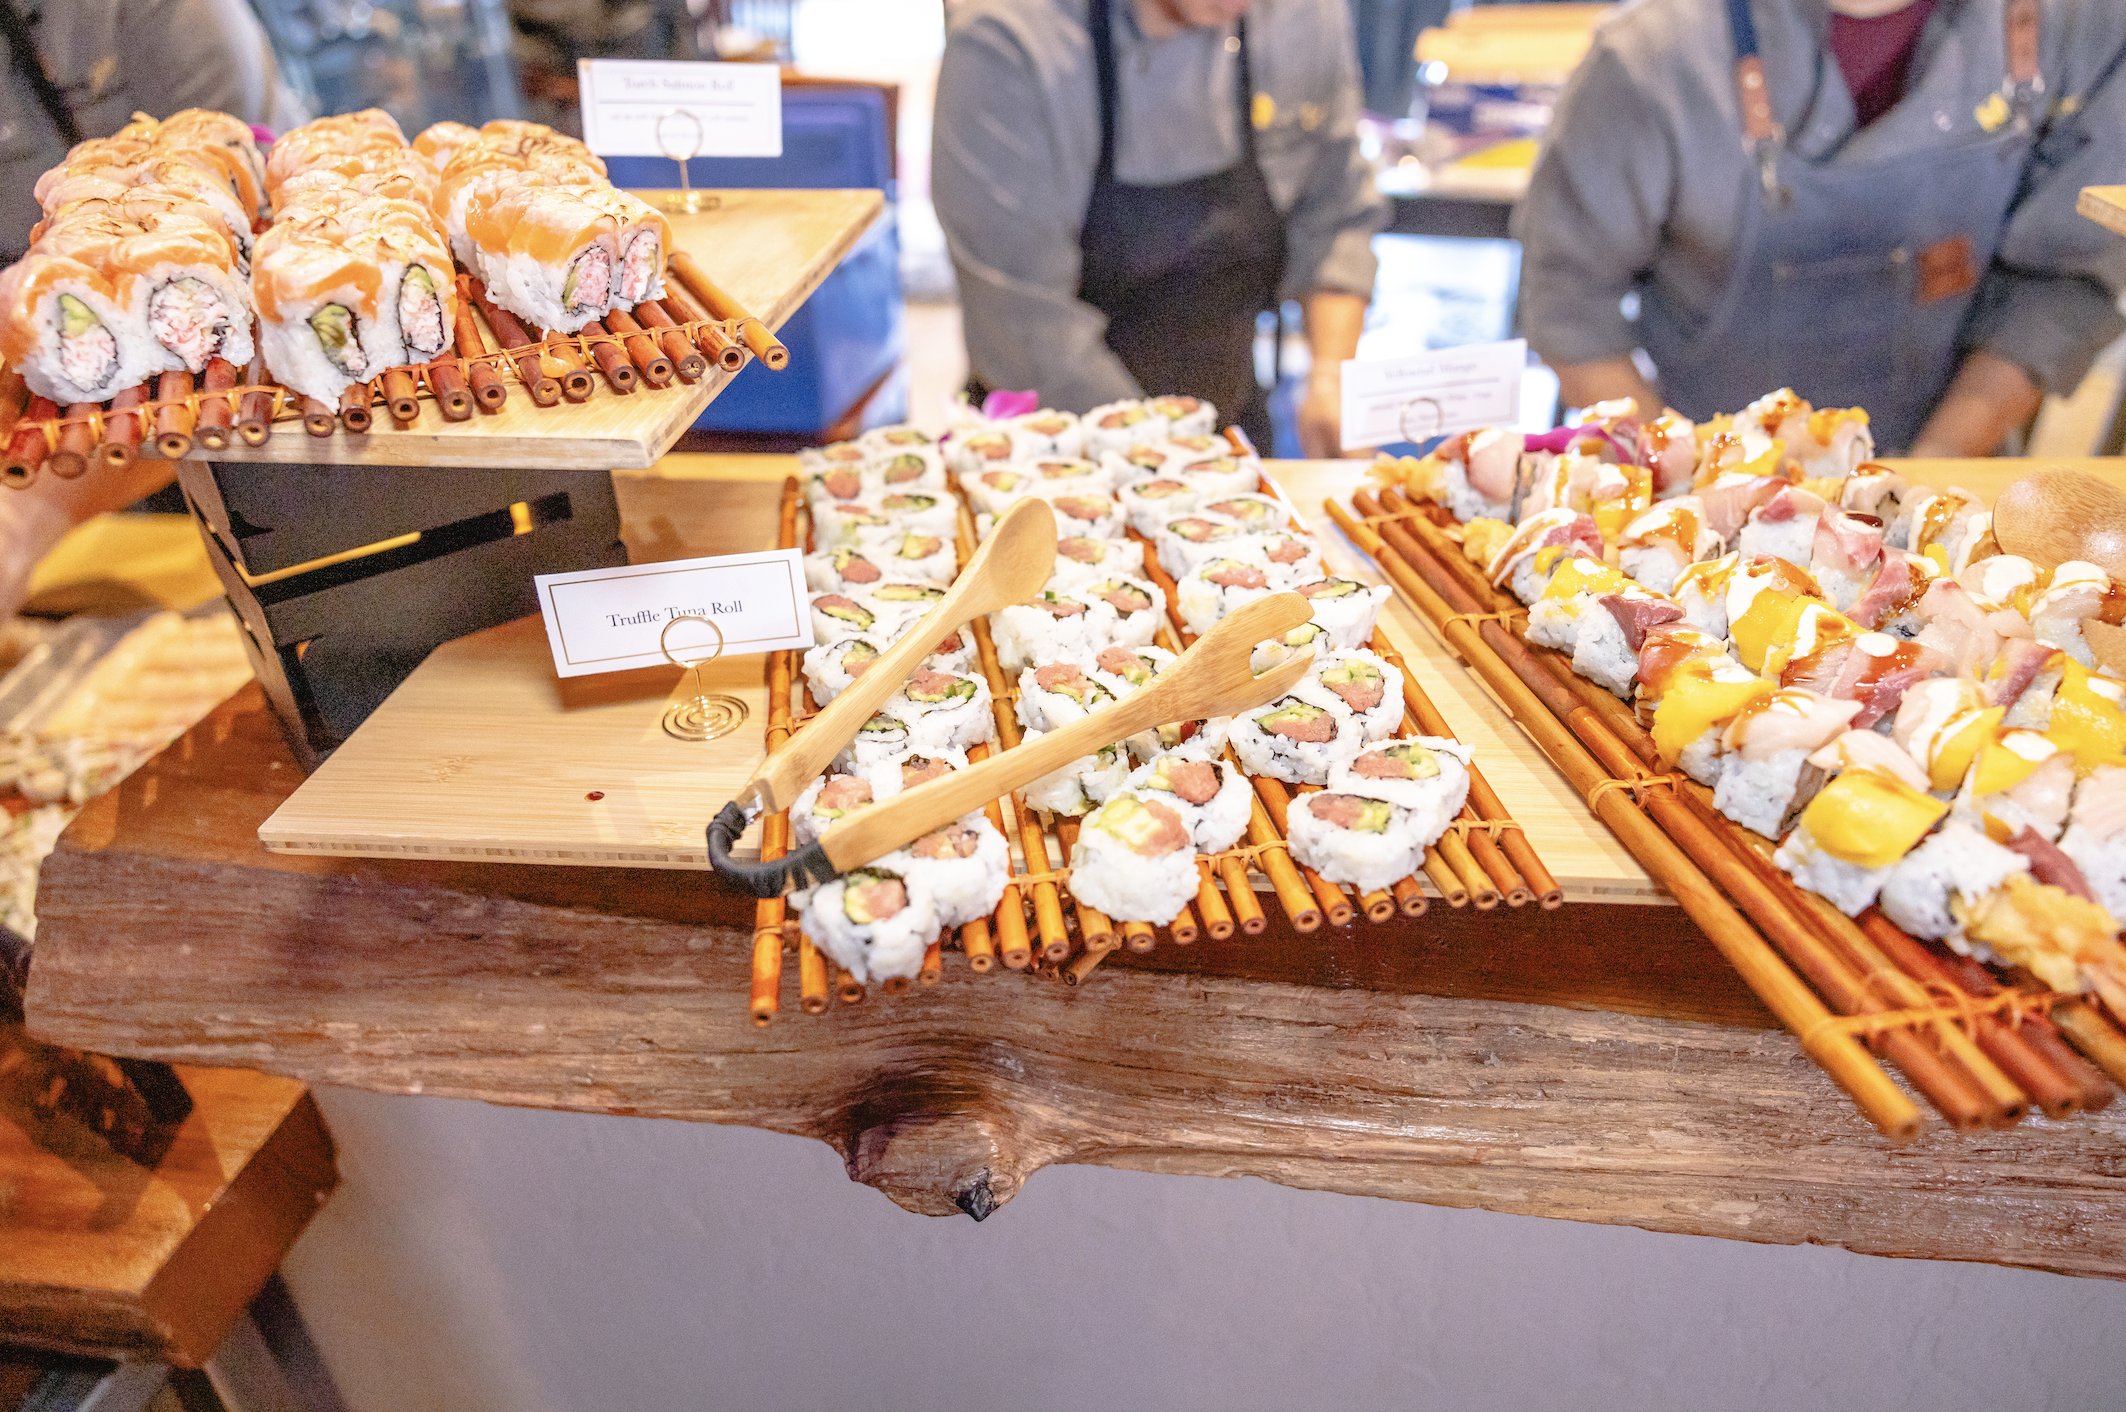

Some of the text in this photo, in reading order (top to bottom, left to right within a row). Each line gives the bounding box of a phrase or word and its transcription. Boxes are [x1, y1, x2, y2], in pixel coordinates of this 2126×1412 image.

[605, 600, 743, 627] Truffle Tuna Roll
